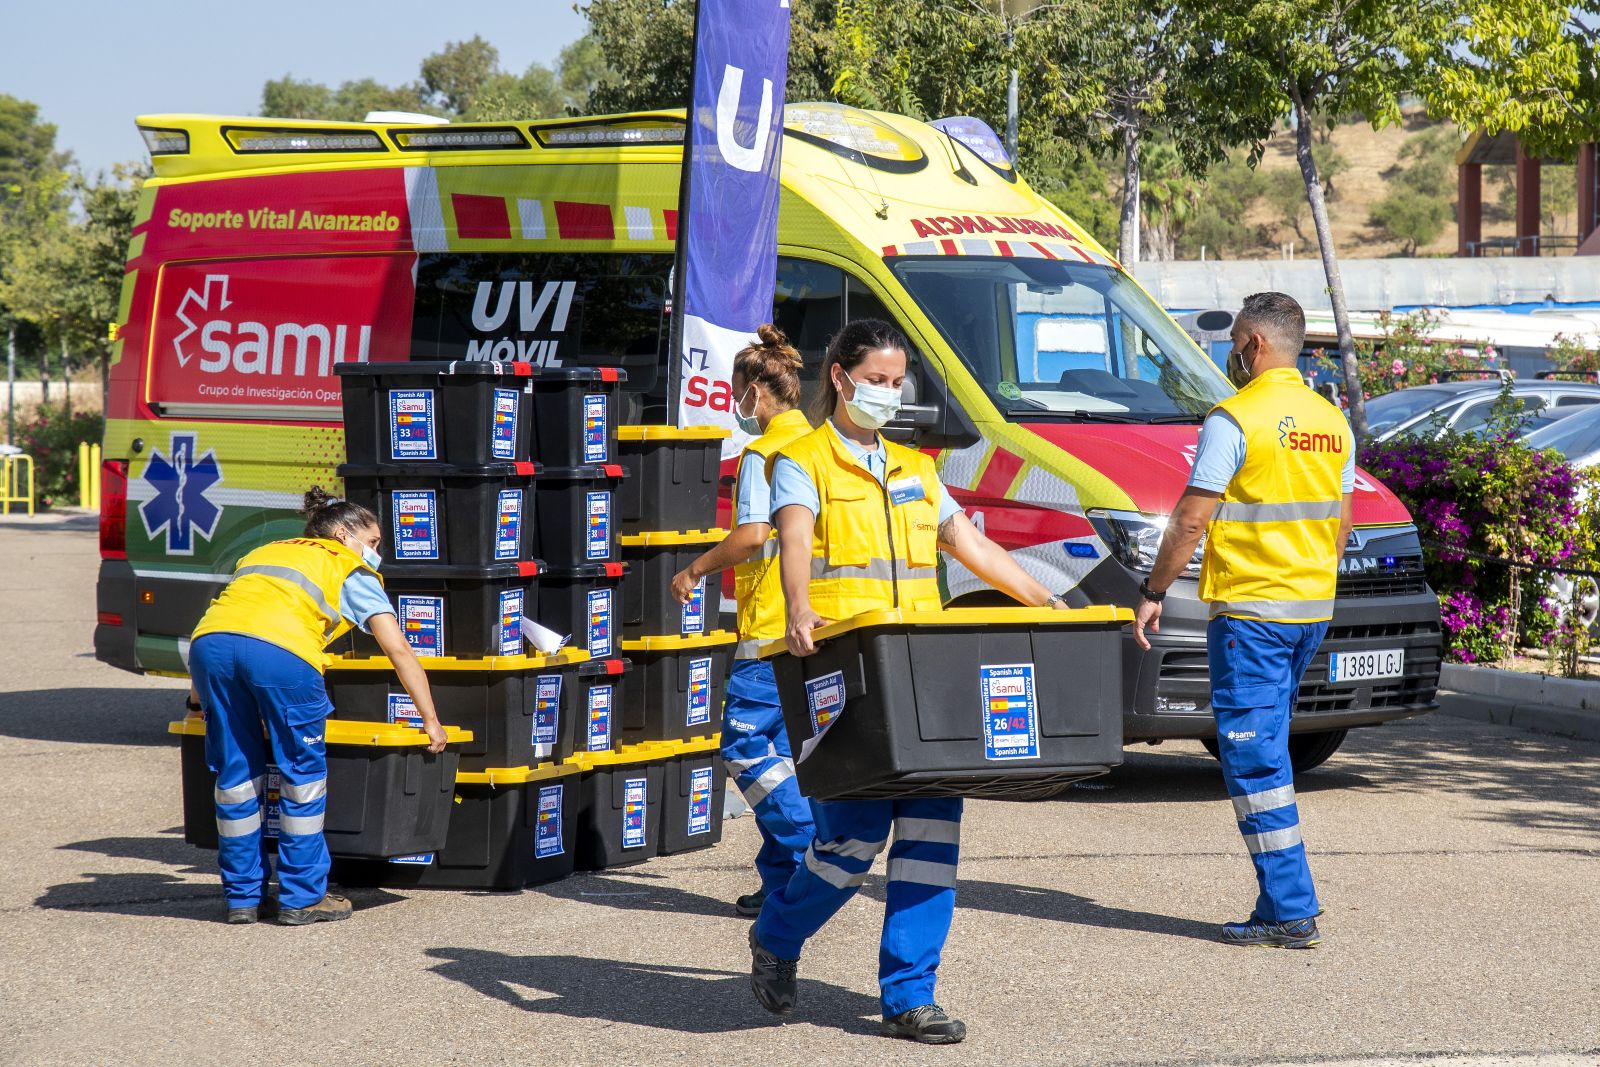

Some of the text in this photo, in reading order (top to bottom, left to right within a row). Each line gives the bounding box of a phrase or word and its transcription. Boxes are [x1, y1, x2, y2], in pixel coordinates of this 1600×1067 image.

[168, 208, 400, 232] Soporte Vital Avanzado
[472, 281, 576, 332] UVI
[200, 320, 372, 377] samu
[465, 337, 563, 368] MÓVIL
[198, 384, 342, 402] Grupo de Investigación Oper
[684, 376, 736, 414] sa
[400, 428, 425, 438] 33/42
[1289, 432, 1342, 453] samu
[402, 528, 427, 538] 32/42
[409, 634, 434, 645] 31/42
[1343, 653, 1402, 678] 1389 LGJ
[813, 679, 829, 690] Spanish
[996, 684, 1022, 693] samu
[820, 693, 838, 705] samu
[736, 721, 756, 730] samu
[994, 716, 1025, 732] 26/42
[1027, 702, 1035, 746] Humanitaria
